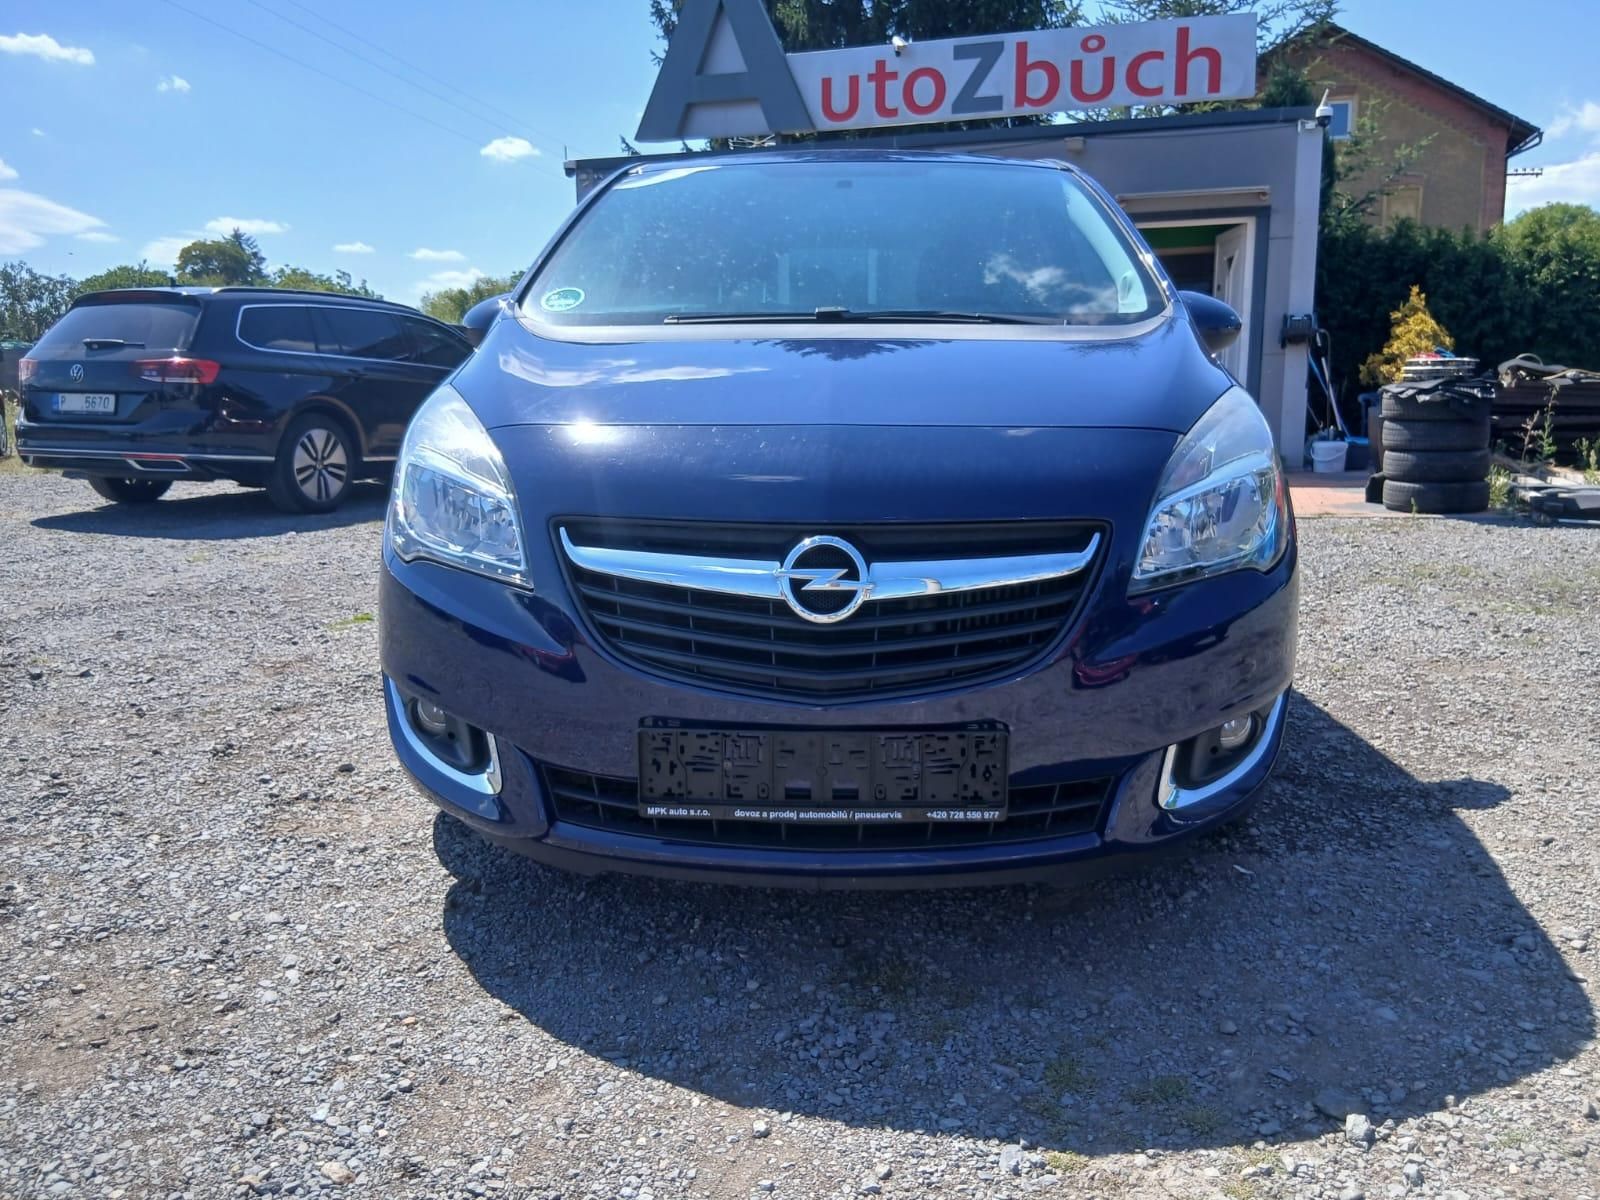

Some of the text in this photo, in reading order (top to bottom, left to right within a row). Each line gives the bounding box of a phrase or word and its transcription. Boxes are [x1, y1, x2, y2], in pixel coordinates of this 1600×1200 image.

[647, 807, 667, 815] MPK
[668, 808, 687, 816] auto
[689, 808, 711, 816] s.r.o.
[734, 809, 760, 817] dovoz
[769, 810, 797, 820] prodej
[799, 809, 848, 819] automobilů
[854, 810, 902, 820] pneuservis
[926, 811, 947, 819] +420
[949, 811, 964, 819] 728
[966, 811, 982, 819] 550
[983, 811, 999, 820] 977
